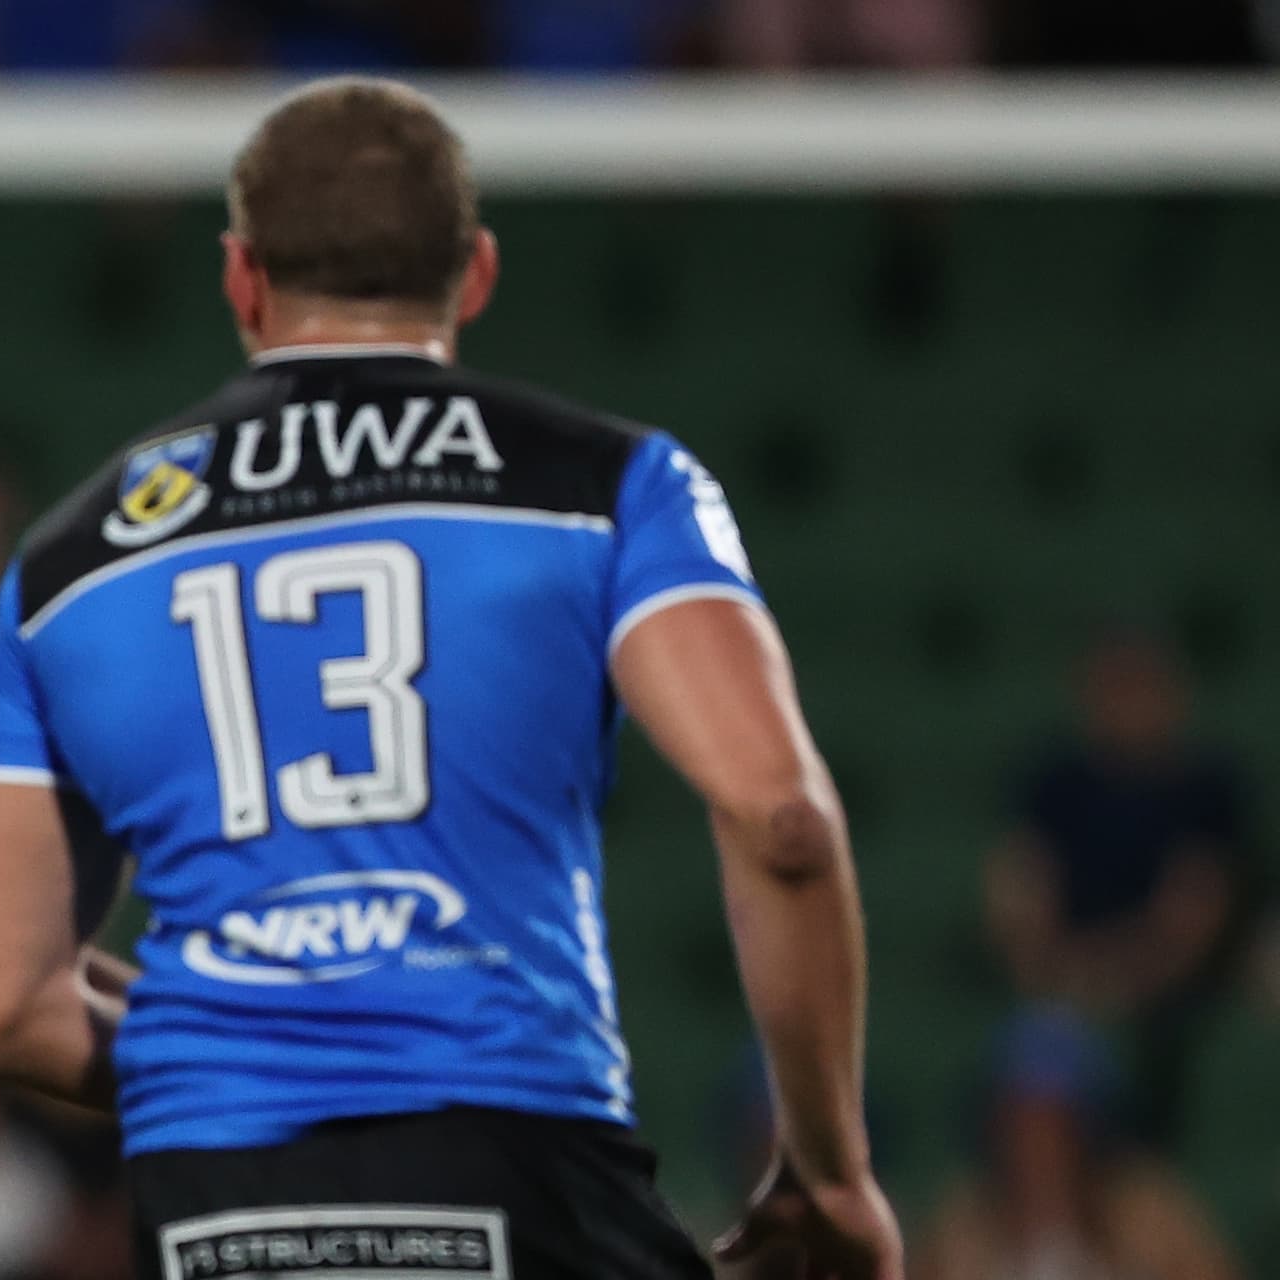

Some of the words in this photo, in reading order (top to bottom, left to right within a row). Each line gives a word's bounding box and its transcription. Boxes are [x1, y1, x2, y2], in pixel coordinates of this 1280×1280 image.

[230, 396, 504, 490] UWA
[171, 539, 430, 842] 13
[220, 893, 420, 958] NRW
